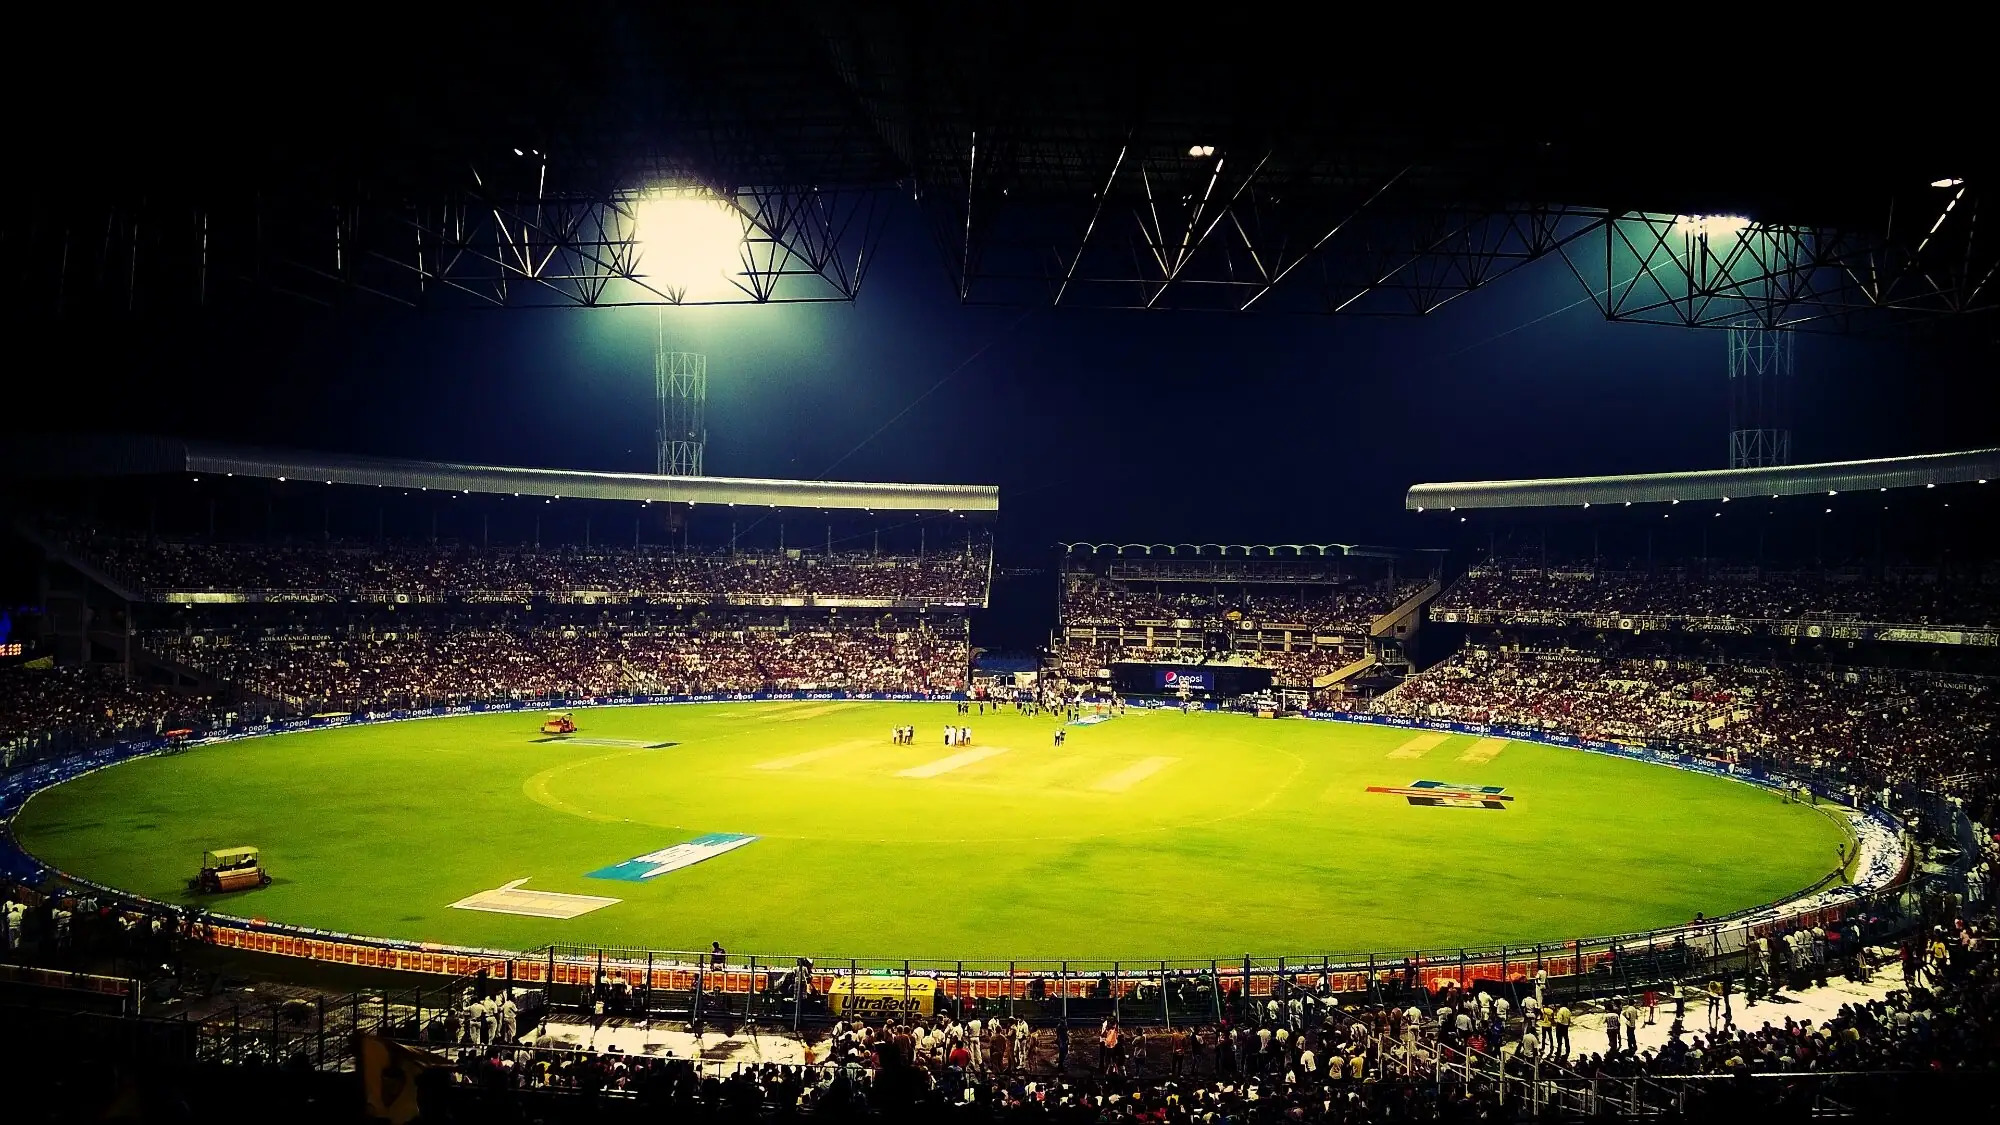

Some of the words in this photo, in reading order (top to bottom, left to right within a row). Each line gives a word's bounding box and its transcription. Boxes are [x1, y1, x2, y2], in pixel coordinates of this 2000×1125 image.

[412, 708, 432, 717] pepsi
[452, 705, 471, 713] pepsi
[248, 724, 268, 732] pepsi
[289, 719, 310, 728] pepsi
[208, 729, 228, 738] pepsi
[1550, 734, 1569, 744] pepsi
[1587, 739, 1606, 749] pepsi
[1662, 752, 1679, 762] pepsi
[842, 996, 920, 1010] UltraTech
